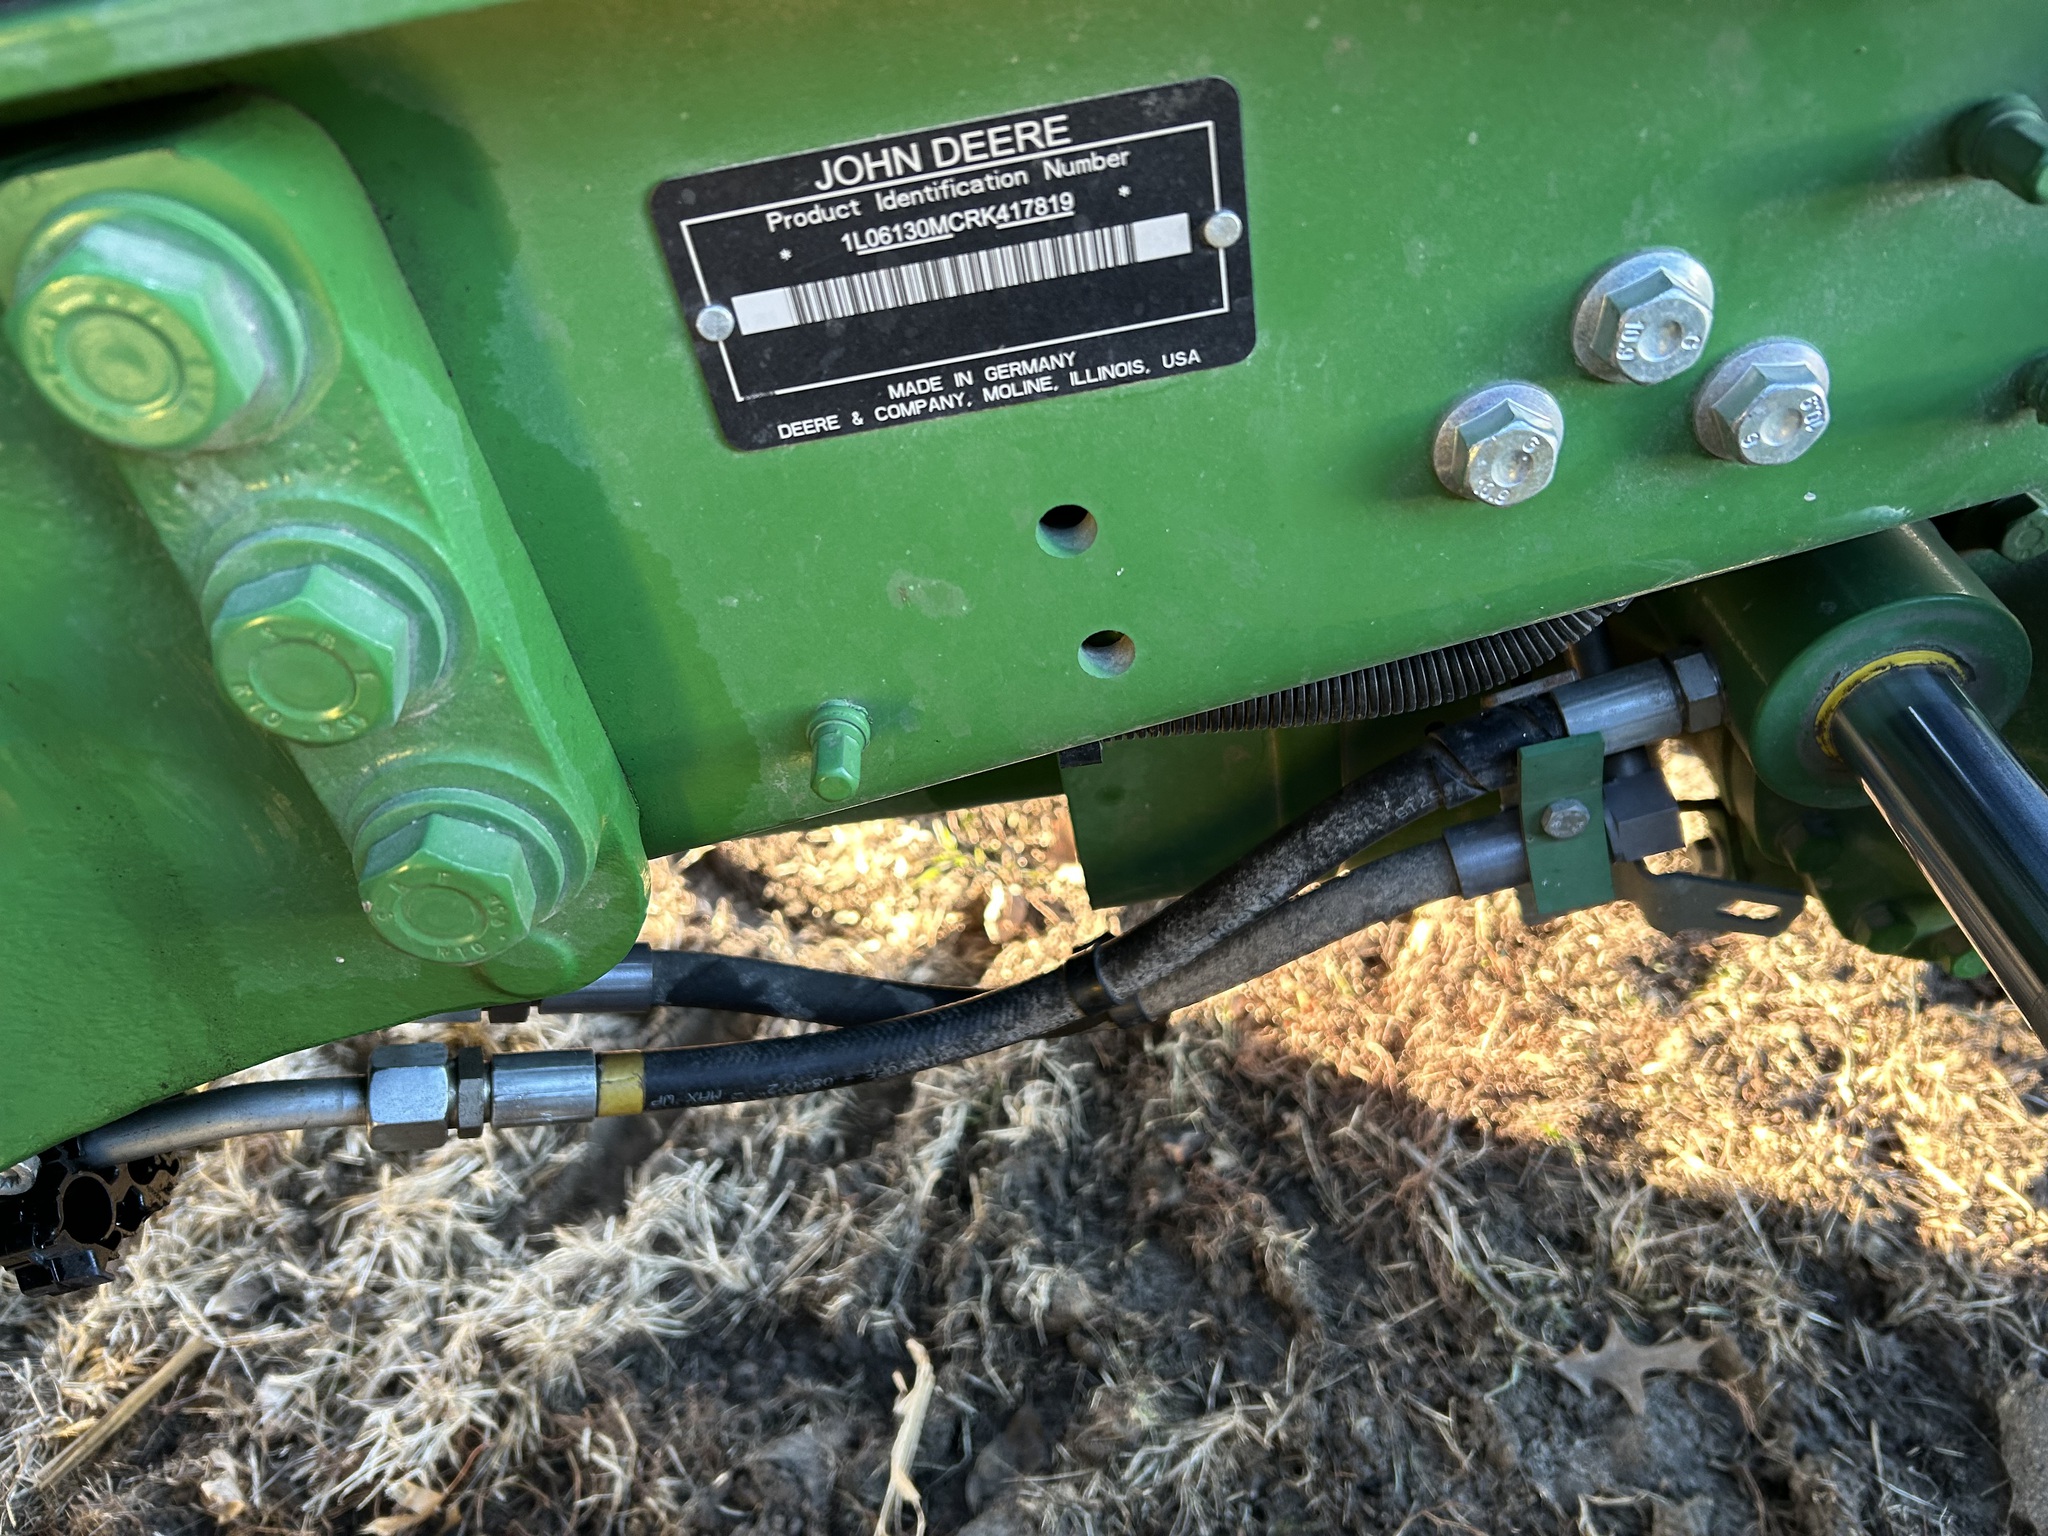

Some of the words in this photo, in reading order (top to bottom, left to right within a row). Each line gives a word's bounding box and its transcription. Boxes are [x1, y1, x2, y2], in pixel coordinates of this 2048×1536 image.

[765, 198, 862, 233] Product
[874, 167, 1030, 213] Identification
[1041, 150, 1131, 182] Number
[814, 141, 924, 192] JOHN
[930, 113, 1073, 170] DEERE
[840, 190, 1076, 255] 1L06130MCRK417819
[777, 414, 841, 440] DEERE
[851, 410, 865, 426] &
[873, 391, 974, 423] COMPANY,
[981, 375, 1060, 404] MOLINE,
[1069, 359, 1151, 388] ILLINOIS,
[1161, 348, 1202, 370] USA
[887, 375, 944, 400] MADE
[953, 369, 974, 388] IN
[983, 350, 1077, 382] GERMANY
